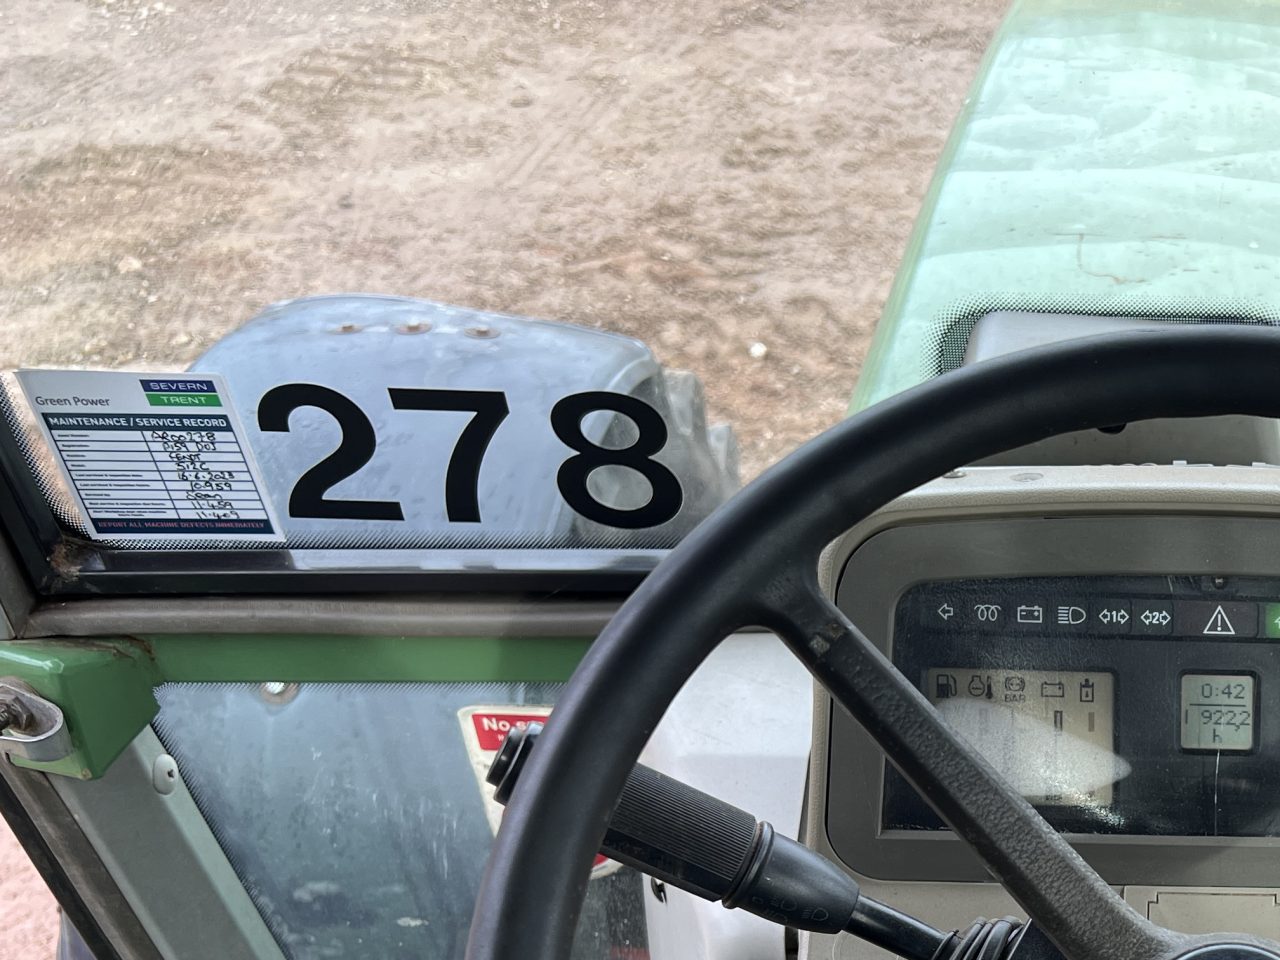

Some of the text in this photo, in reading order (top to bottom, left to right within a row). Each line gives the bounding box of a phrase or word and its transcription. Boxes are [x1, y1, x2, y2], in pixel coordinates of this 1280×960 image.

[150, 382, 208, 391] SEVERN
[35, 396, 110, 407] Green Power
[160, 395, 207, 405] TRENT
[48, 417, 127, 427] MAINTENANCE
[135, 418, 181, 428] SERVICE
[182, 418, 228, 428] RECORD
[257, 383, 683, 529] 278
[1201, 683, 1245, 699] 0:42
[482, 717, 511, 732] No
